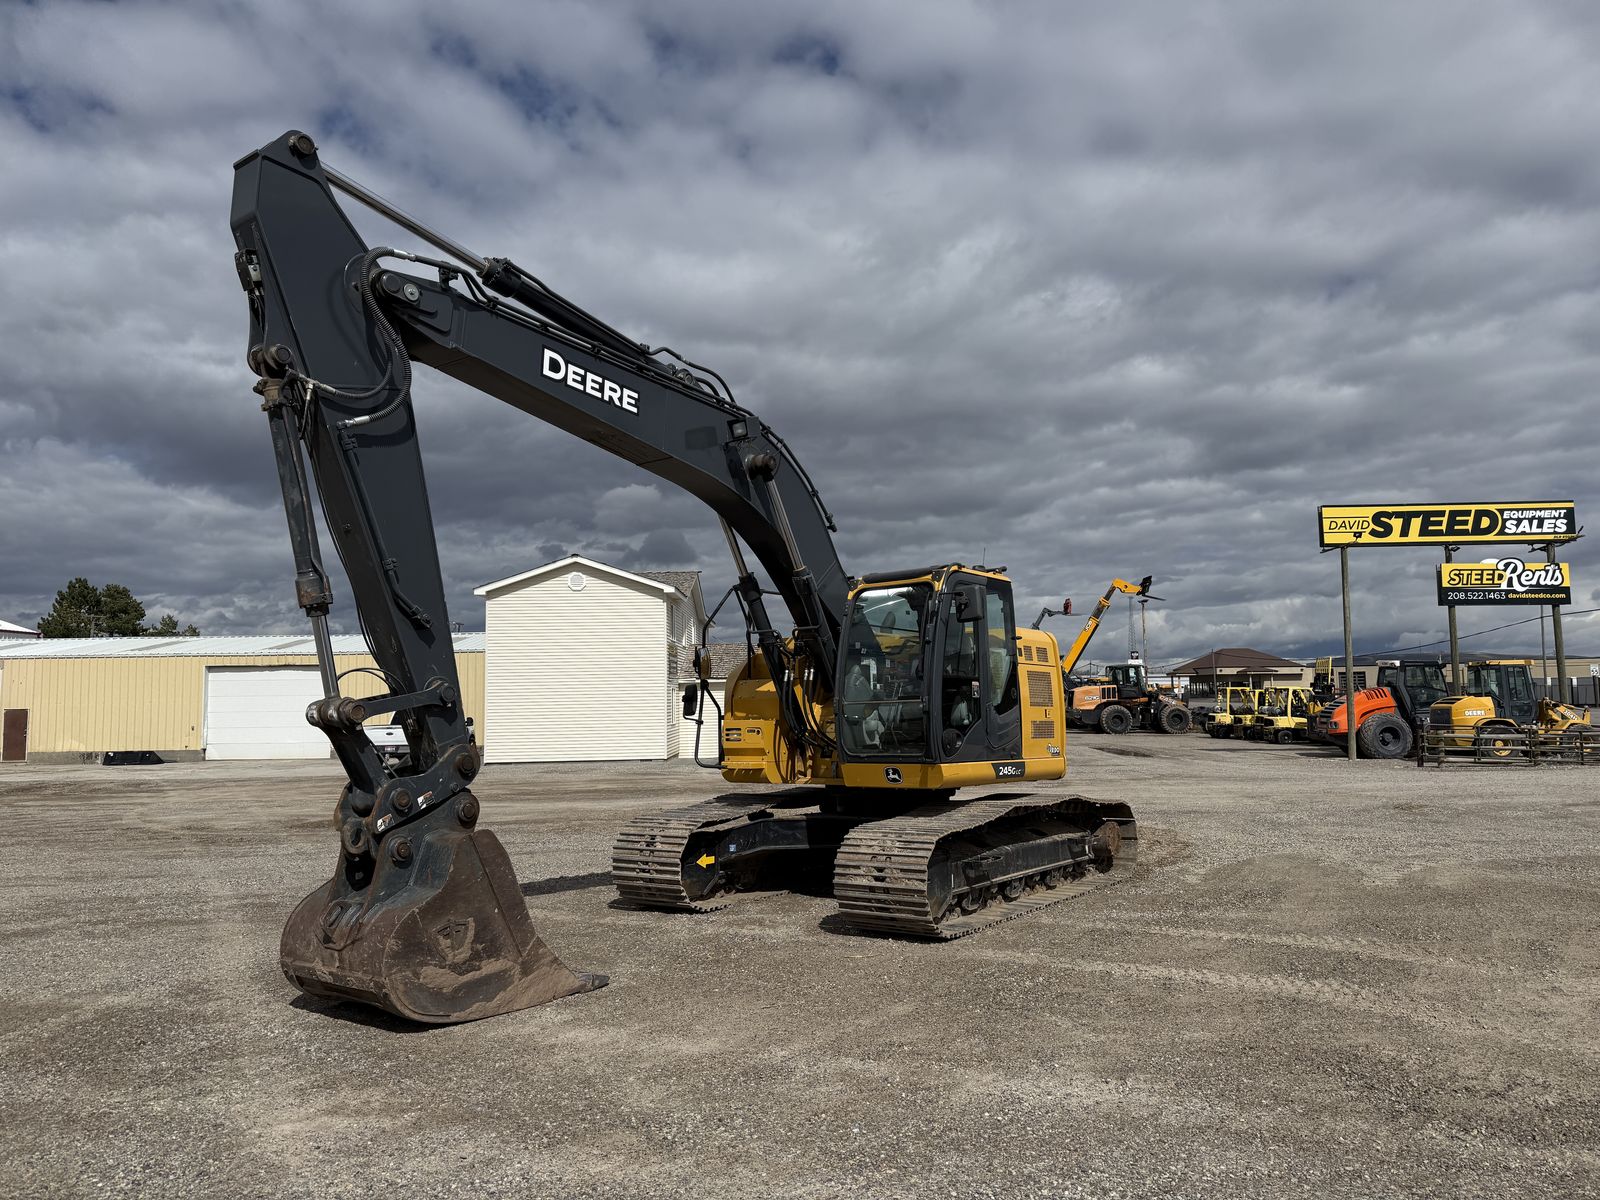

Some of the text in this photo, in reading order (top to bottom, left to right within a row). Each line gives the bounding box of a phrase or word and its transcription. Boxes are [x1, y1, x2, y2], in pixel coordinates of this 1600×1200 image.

[542, 347, 639, 414] DEERE
[1502, 509, 1567, 519] EQUIPMENT
[1328, 509, 1499, 539] DAVID STEED
[1503, 518, 1568, 534] SALES
[1448, 557, 1564, 592] STEED Rents
[1447, 591, 1506, 600] 208.522.1463
[998, 765, 1016, 776] 245G
